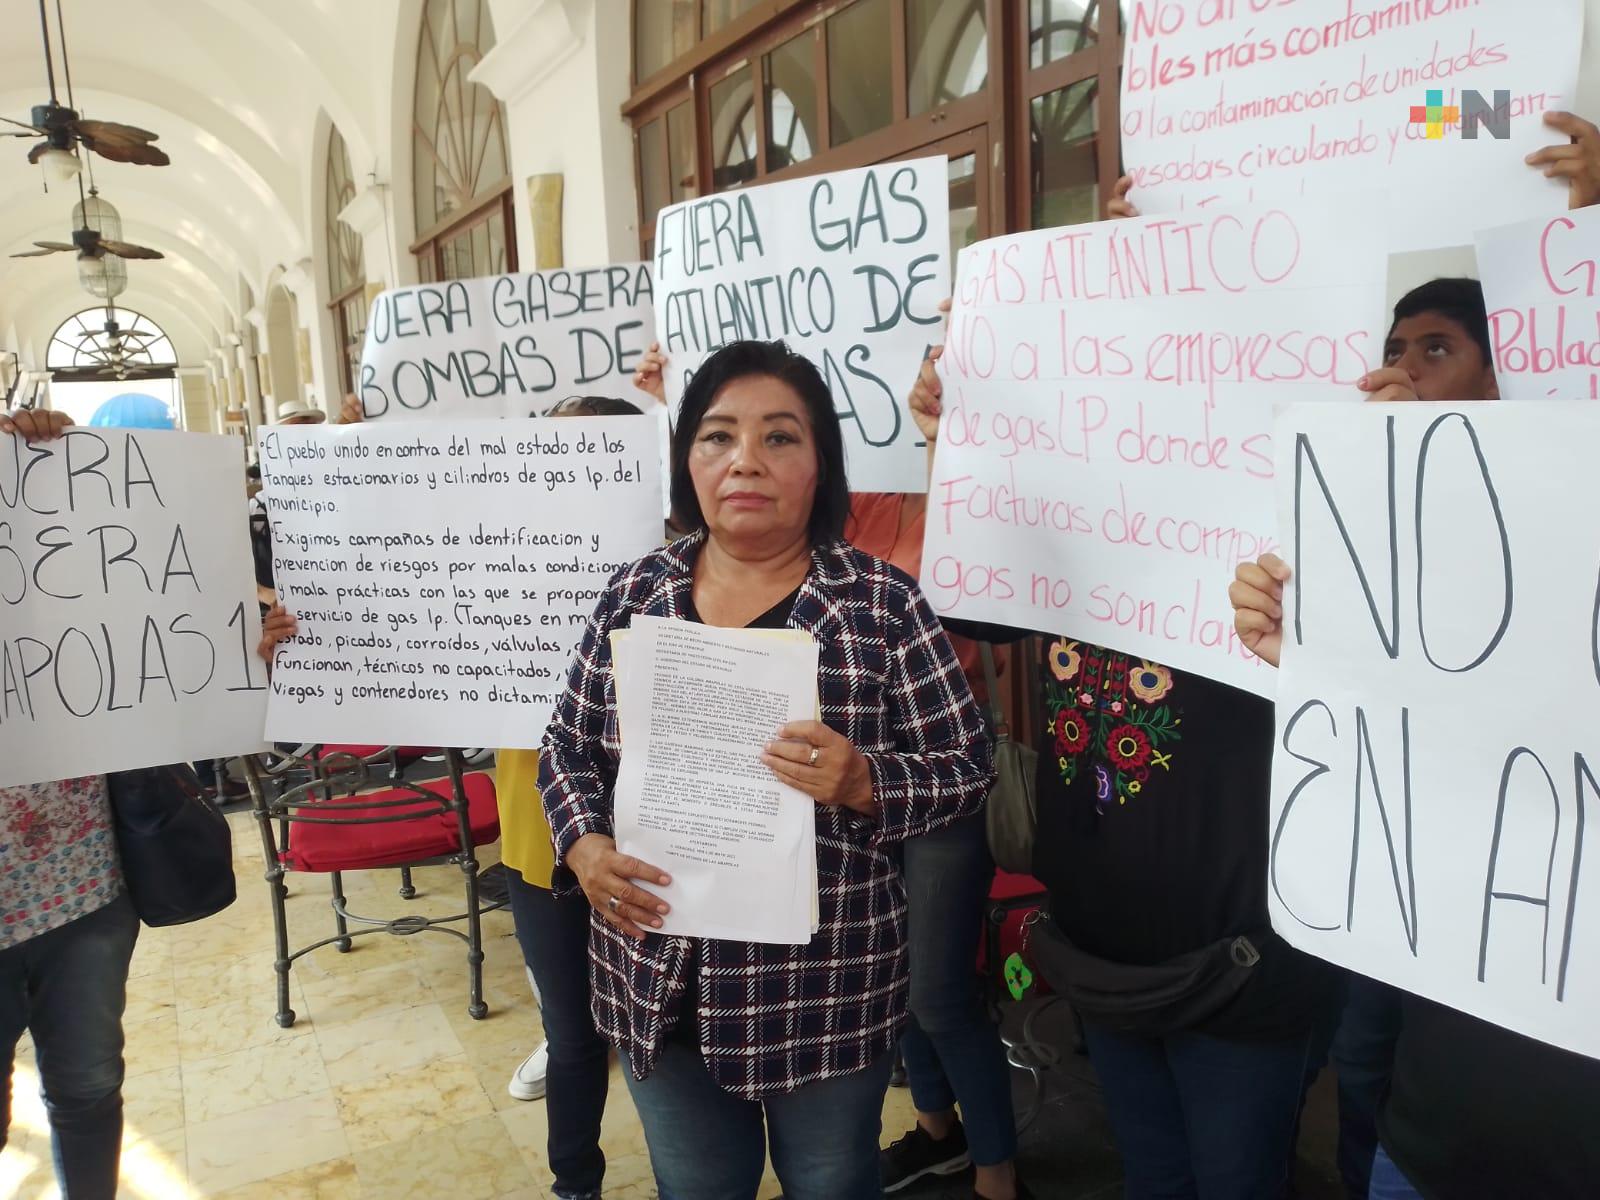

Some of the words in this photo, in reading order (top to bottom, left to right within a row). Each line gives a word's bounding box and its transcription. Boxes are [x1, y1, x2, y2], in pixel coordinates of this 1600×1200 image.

[1122, 109, 1143, 137] a
[1149, 95, 1174, 139] la
[1179, 79, 1339, 134] contaminación
[1343, 53, 1378, 103] de
[1383, 28, 1509, 94] unidades
[1127, 43, 1196, 92] bles
[1203, 28, 1278, 76] más
[1238, 120, 1378, 178] circulando
[1386, 125, 1399, 165] y
[658, 192, 764, 281] FUERA
[809, 167, 928, 254] GAS
[960, 243, 1026, 309] GAS
[1040, 210, 1300, 302] ATLÁNTICO
[492, 264, 653, 328] GASERA
[665, 266, 835, 353] ATLANTICO
[853, 253, 943, 334] DE
[361, 335, 557, 418] BOMBAS
[569, 320, 643, 384] DE
[1010, 342, 1039, 381] a
[1060, 308, 1134, 381] las
[1144, 329, 1370, 408] empresas
[265, 432, 282, 460] El
[286, 439, 327, 469] pueblo
[334, 435, 370, 458] unido
[448, 434, 471, 457] del
[480, 435, 507, 456] mal
[516, 433, 570, 456] estado
[576, 431, 597, 454] de
[602, 431, 626, 454] los
[946, 385, 987, 447] de
[992, 411, 1056, 458] gas
[1059, 389, 1109, 464] LP
[1116, 401, 1232, 465] donde
[264, 463, 314, 492] tanques
[323, 467, 420, 486] estacionarios
[427, 472, 437, 490] y
[444, 462, 510, 485] cilindros
[518, 462, 537, 484] de
[544, 470, 576, 492] gas
[613, 459, 642, 483] del
[268, 495, 340, 518] municipio.
[939, 460, 1093, 536] Facturas
[1102, 481, 1151, 548] de
[272, 521, 341, 553] Exigimos
[349, 532, 434, 552] campañas
[442, 526, 461, 546] de
[469, 522, 583, 546] identificacion
[591, 533, 600, 553] y
[274, 557, 348, 579] prevencion
[355, 552, 374, 573] de
[381, 559, 439, 580] riesgos
[449, 561, 476, 580] por
[486, 554, 537, 573] malas
[1294, 412, 1514, 674] NO
[278, 583, 285, 601] y
[289, 581, 329, 597] mala
[336, 582, 411, 606] prácticas
[420, 588, 445, 599] con
[453, 584, 476, 600] las
[484, 587, 510, 604] que
[522, 589, 538, 600] se
[296, 609, 353, 623] servicio
[361, 607, 379, 624] de
[388, 612, 418, 632] gas
[453, 601, 532, 631] (Tanques
[540, 613, 562, 626] en
[932, 555, 1015, 612] gas
[1031, 572, 1072, 609] no
[1088, 582, 1156, 638] son
[335, 630, 400, 653] picados,
[406, 632, 489, 655] corroídos,
[491, 634, 572, 657] válvulas,
[364, 656, 425, 674] técnicos
[432, 662, 450, 676] no
[456, 659, 561, 682] capacitados,
[334, 686, 343, 706] y
[352, 680, 449, 702] contenedores
[459, 688, 479, 702] no
[1271, 698, 1418, 958] EN
